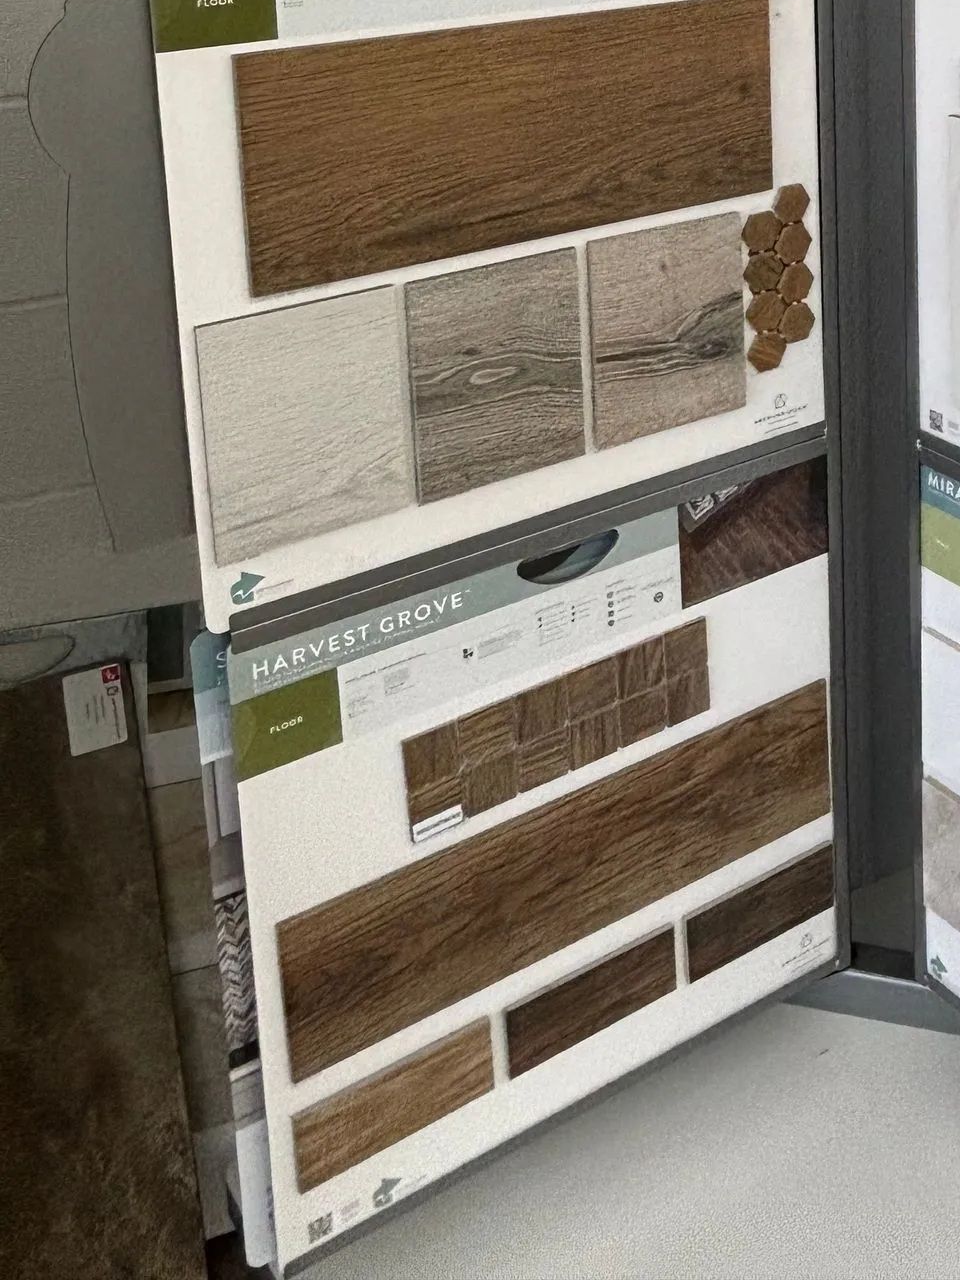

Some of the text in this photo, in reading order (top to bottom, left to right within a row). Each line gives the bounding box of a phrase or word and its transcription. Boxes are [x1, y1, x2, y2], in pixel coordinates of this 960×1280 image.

[251, 622, 371, 681] HARVEST
[378, 592, 464, 634] GROVE
[269, 714, 304, 735] FLOOR
